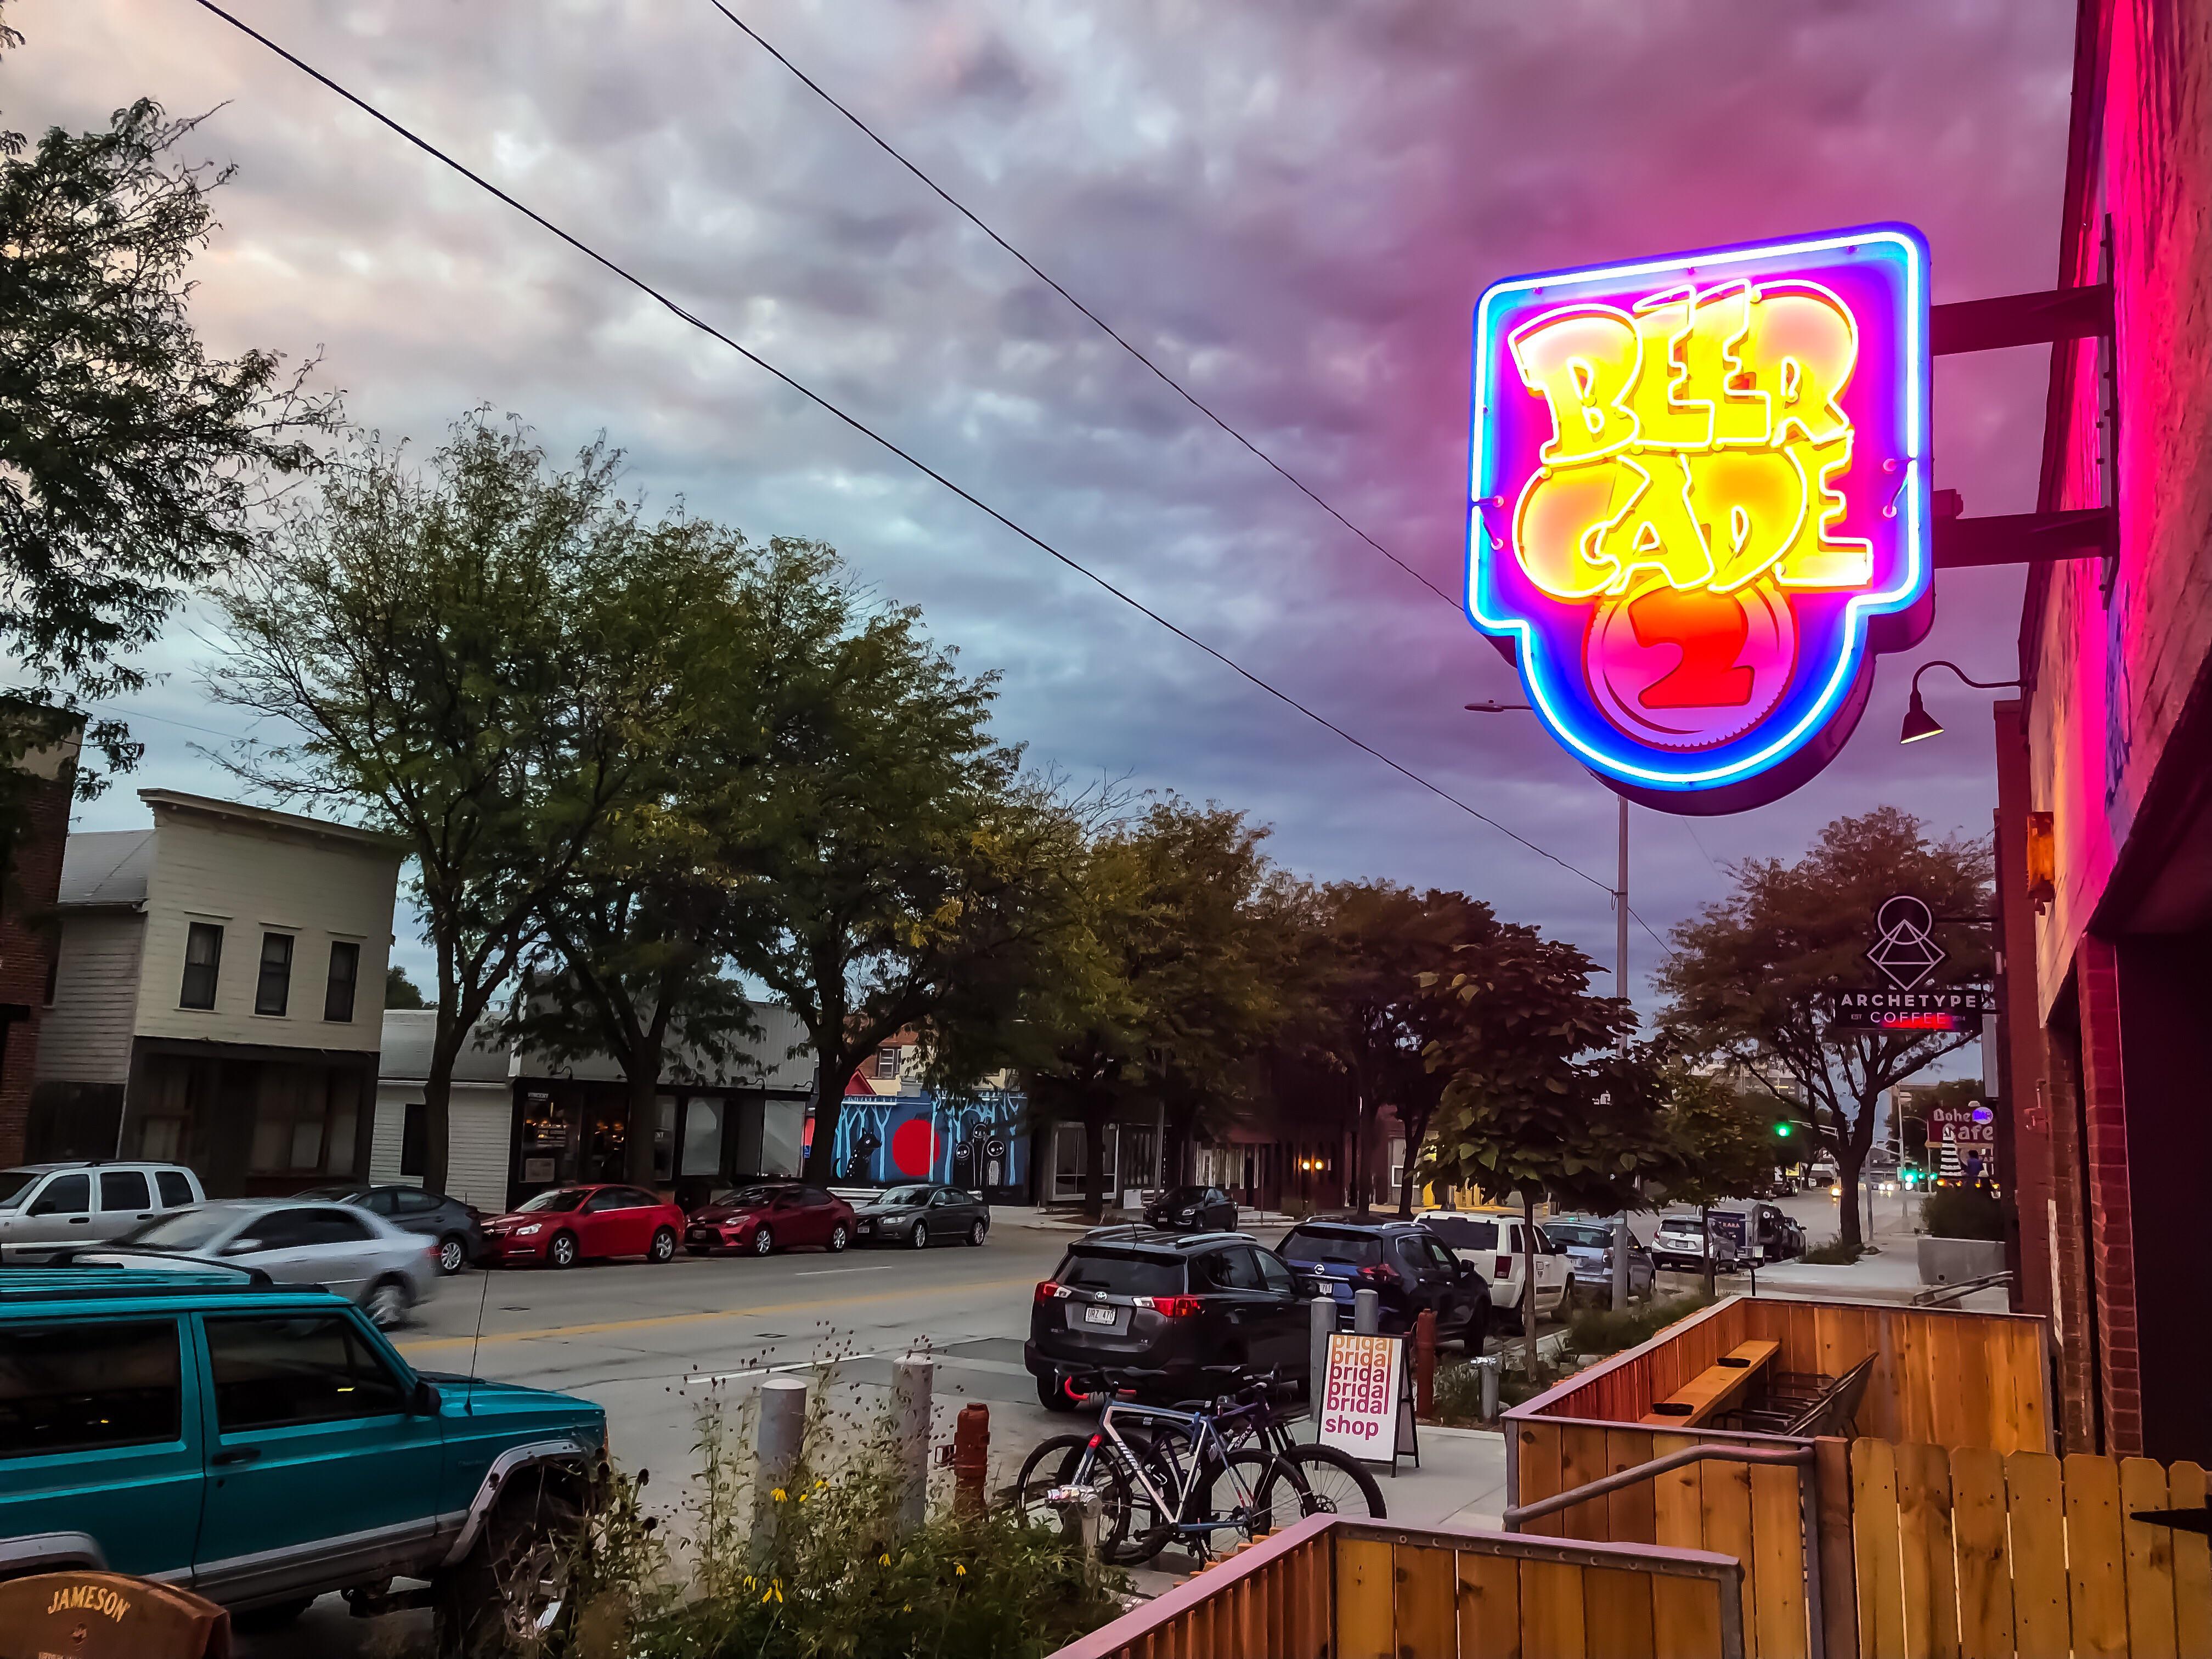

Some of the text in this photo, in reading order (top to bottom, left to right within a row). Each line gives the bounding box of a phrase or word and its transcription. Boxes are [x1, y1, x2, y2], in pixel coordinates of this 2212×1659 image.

[1506, 277, 1859, 466] BEER
[1511, 430, 1873, 602] CADE
[1627, 585, 1754, 708] 2
[1841, 994, 1976, 1008] ARCHETYPE
[1870, 1012, 1946, 1024] COFFEE
[1933, 1108, 1971, 1122] Bohe
[1331, 1347, 1392, 1367] bridal
[1330, 1362, 1391, 1383] bridal
[1329, 1377, 1390, 1399] bridal
[1327, 1393, 1389, 1415] bridal
[1324, 1415, 1379, 1441] shop
[48, 1585, 131, 1623] JAMESON
